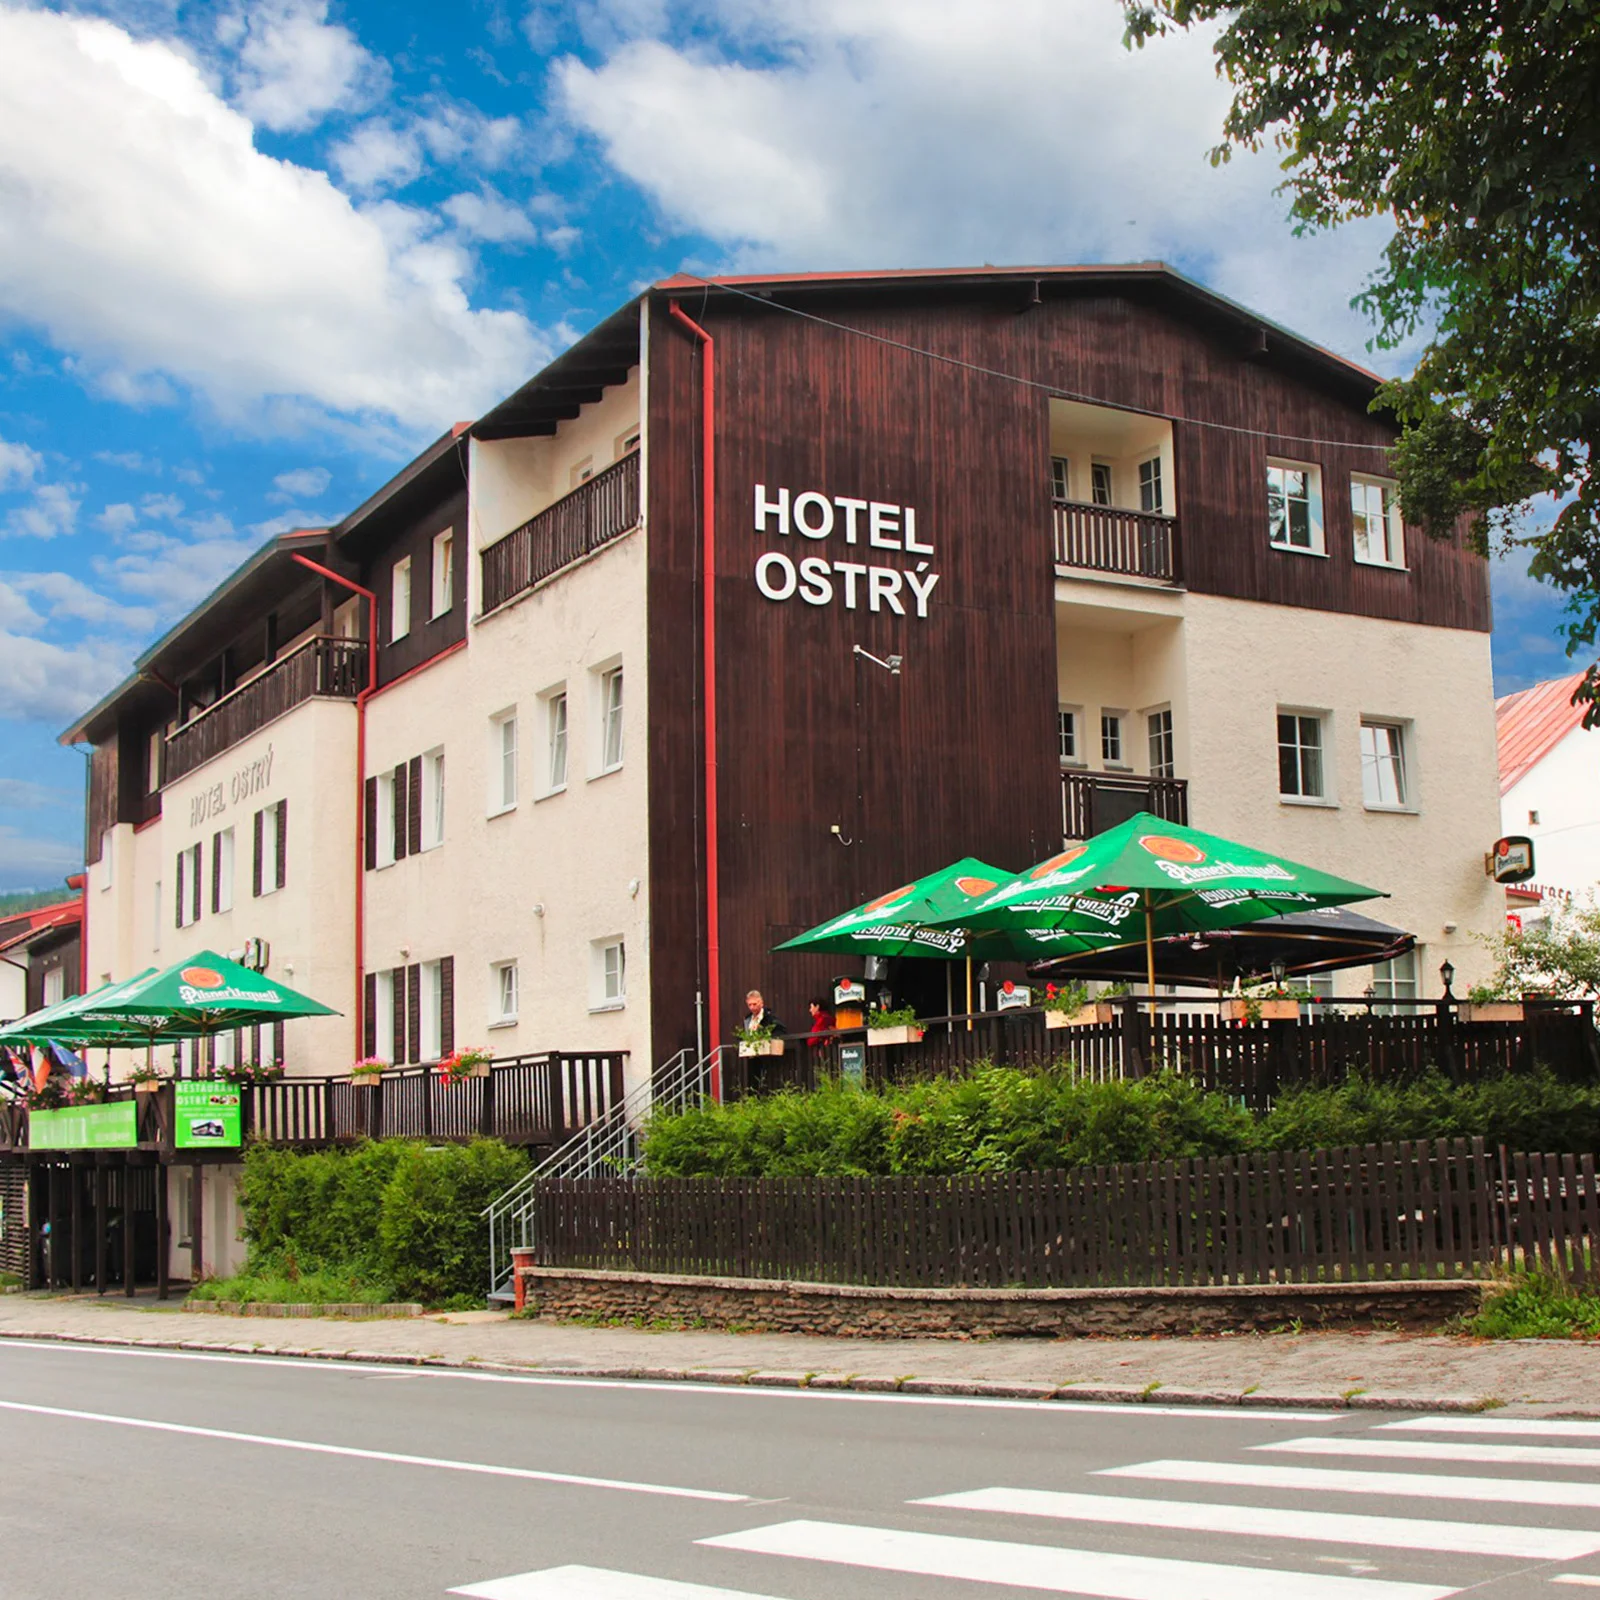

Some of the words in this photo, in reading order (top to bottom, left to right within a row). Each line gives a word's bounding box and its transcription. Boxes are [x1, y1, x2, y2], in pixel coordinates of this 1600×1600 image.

[754, 484, 934, 555] HOTEL
[755, 552, 940, 618] OSTRÝ
[190, 782, 227, 829] HOTEL
[231, 742, 274, 805] OSTRÝ
[1155, 860, 1228, 884] Pilsner
[1215, 860, 1297, 880] Urquell
[179, 985, 231, 1005] Pilsner
[226, 986, 282, 1003] Urquell
